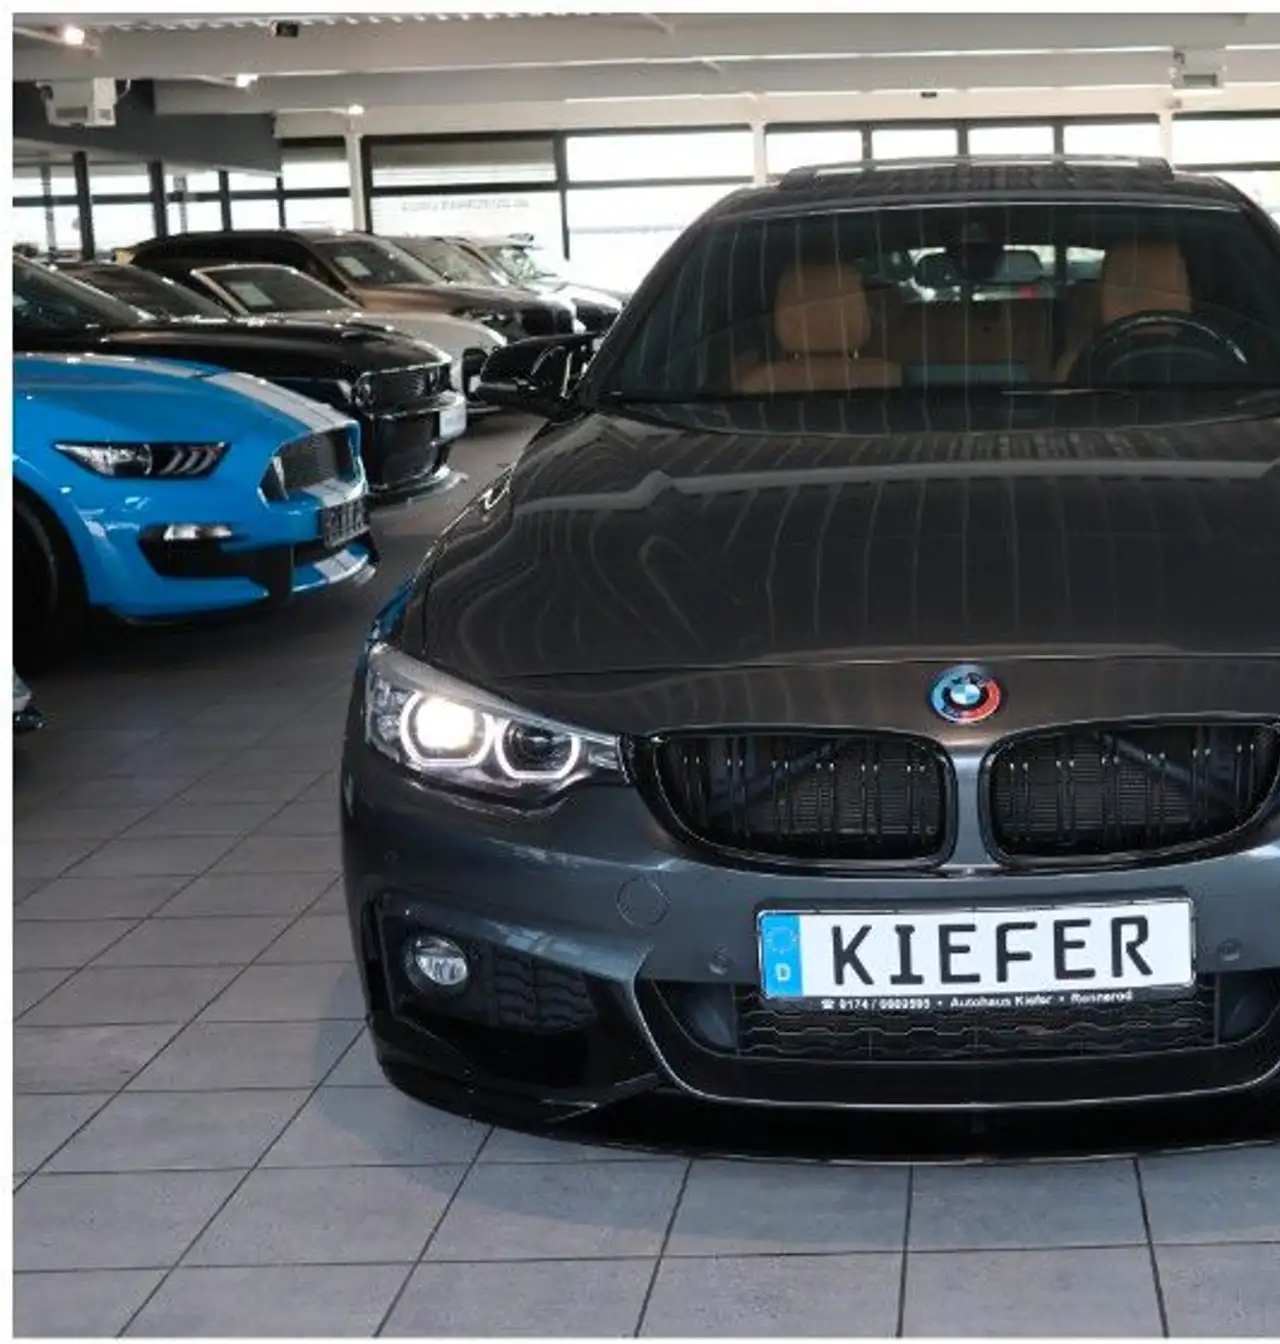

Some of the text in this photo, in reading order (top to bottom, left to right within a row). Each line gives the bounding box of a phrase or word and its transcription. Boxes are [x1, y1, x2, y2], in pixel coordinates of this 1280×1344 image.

[832, 916, 1153, 985] KIEFER
[776, 963, 790, 981] D
[950, 995, 1011, 1009] Autohaus
[1014, 993, 1052, 1006] Kiefer
